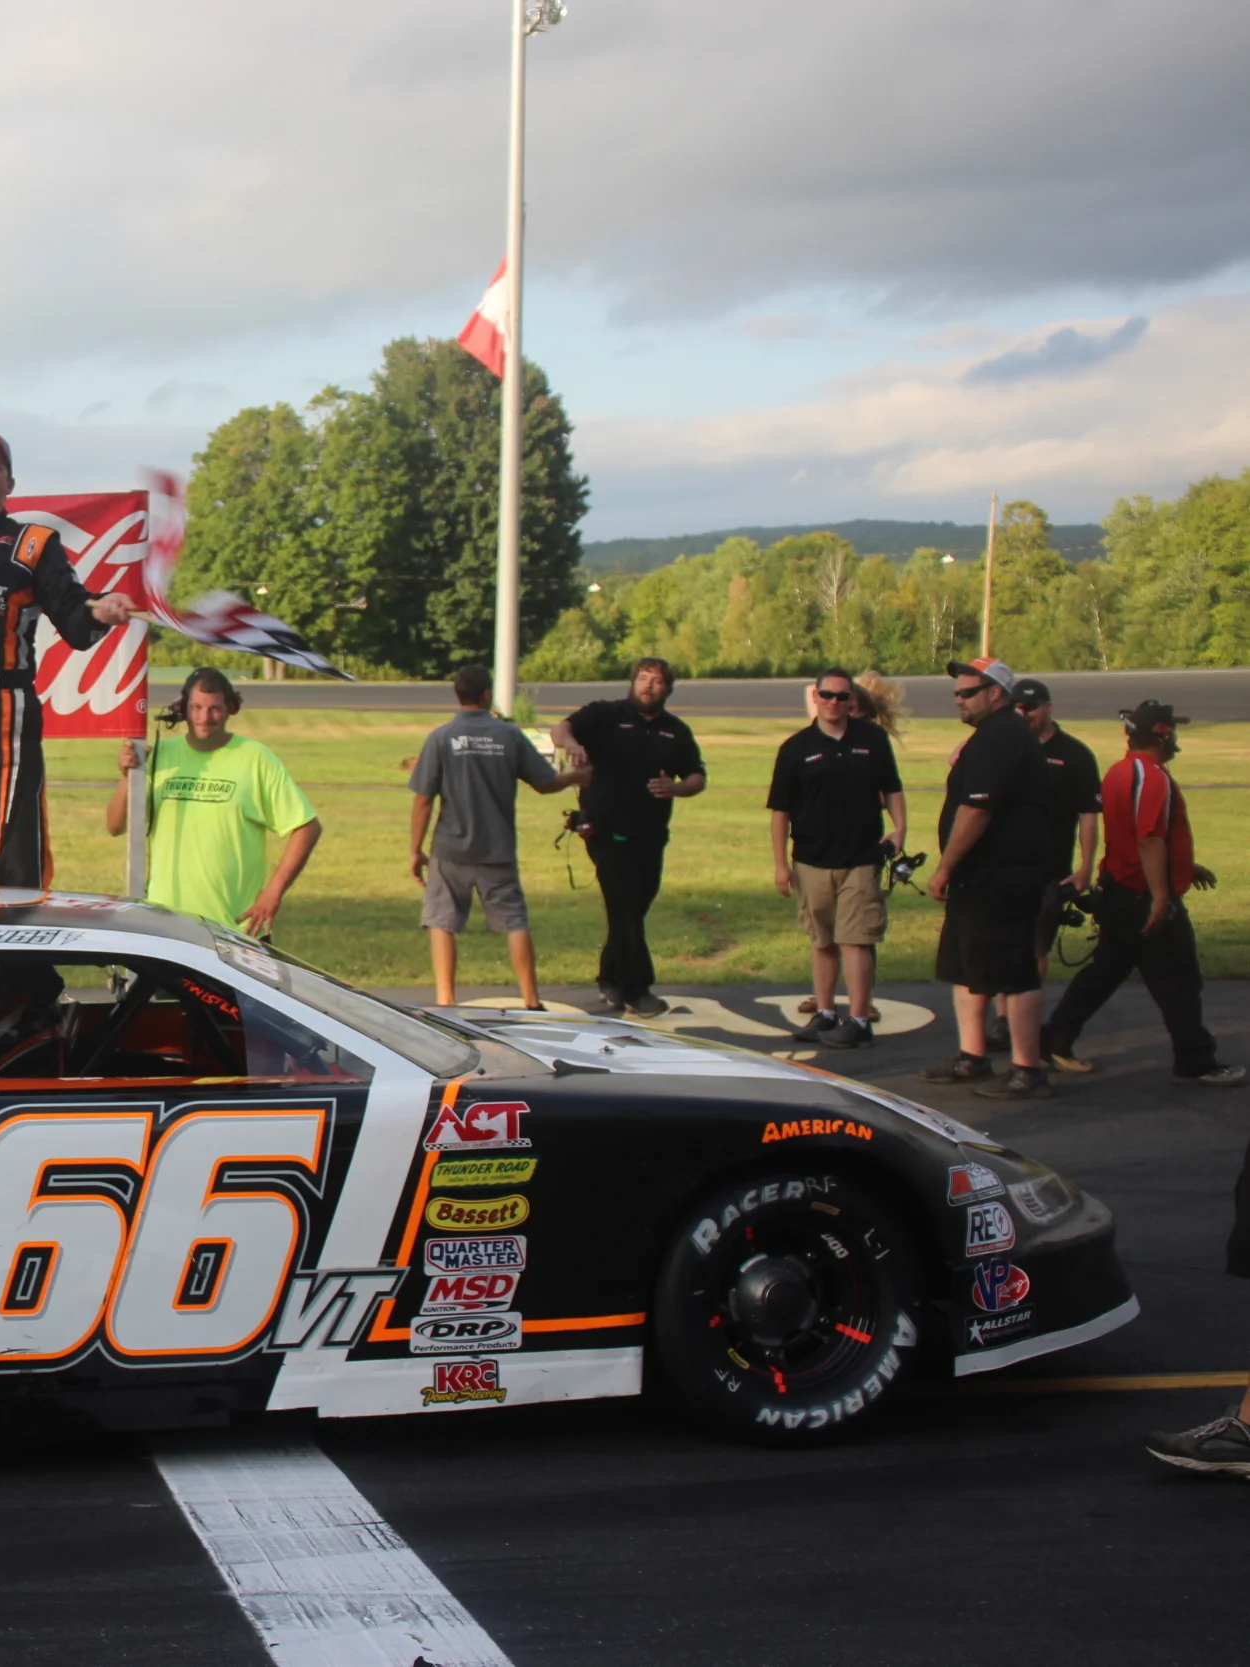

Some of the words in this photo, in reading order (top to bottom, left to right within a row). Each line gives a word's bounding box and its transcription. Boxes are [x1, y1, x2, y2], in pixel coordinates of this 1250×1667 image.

[165, 781, 206, 791] THUNDER
[208, 783, 232, 793] ROAD
[181, 978, 240, 1021] TWISTER
[424, 1101, 530, 1143] ACT
[761, 1119, 874, 1144] AMERICAN
[437, 1163, 493, 1176] THUNDER
[496, 1161, 529, 1173] ROAD
[436, 1200, 519, 1225] Bassett
[689, 1180, 804, 1256] RACER
[430, 1240, 515, 1261] QUARTER
[445, 1252, 519, 1268] MASTER
[429, 1274, 514, 1303] MSD
[975, 1258, 1010, 1311] VP
[265, 1269, 411, 1351] VT
[982, 1311, 1031, 1330] ALLSTAR
[430, 1321, 505, 1338] DRP
[414, 1344, 475, 1352] Performance
[477, 1341, 518, 1349] Products
[436, 1362, 497, 1393] KRC
[755, 1310, 918, 1429] AMERICAN
[421, 1387, 458, 1407] Power
[455, 1386, 507, 1403] Steering
